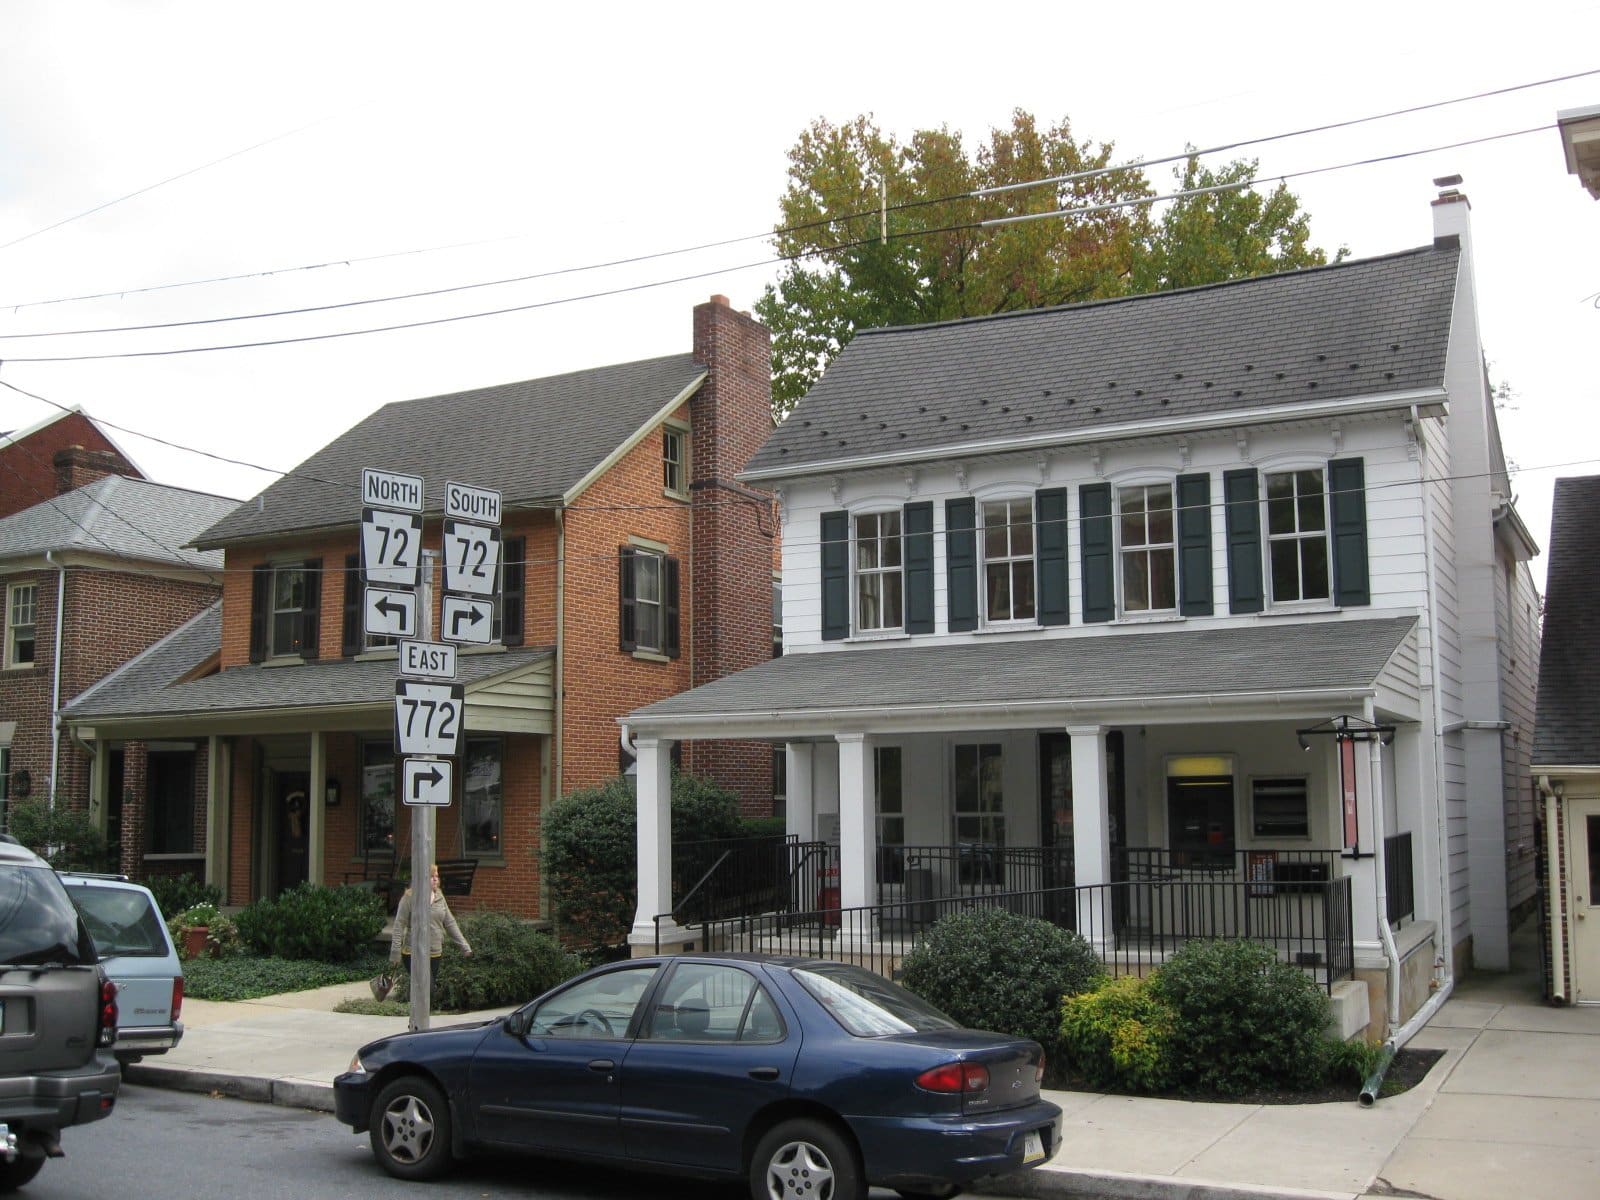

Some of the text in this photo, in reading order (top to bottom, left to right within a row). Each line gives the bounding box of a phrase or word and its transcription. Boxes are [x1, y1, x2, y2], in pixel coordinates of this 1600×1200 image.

[368, 475, 418, 504] NORTH
[450, 488, 497, 517] SOUTH
[375, 526, 409, 567] 72
[457, 538, 488, 578] 72
[408, 646, 448, 671] EAST
[402, 699, 455, 739] 772
